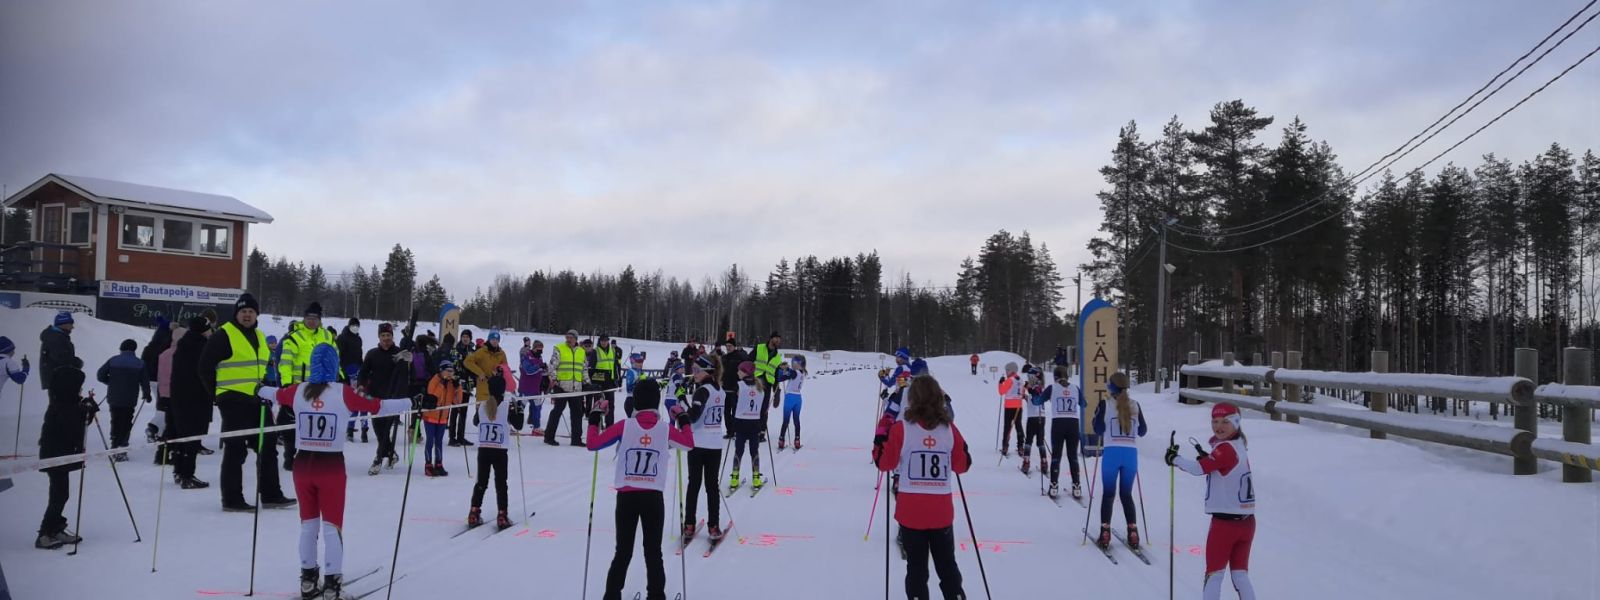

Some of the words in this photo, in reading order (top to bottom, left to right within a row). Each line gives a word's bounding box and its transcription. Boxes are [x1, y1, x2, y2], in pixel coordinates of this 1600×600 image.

[111, 282, 140, 293] Rauta
[141, 285, 194, 298] Rautapohja
[1062, 398, 1073, 411] 12
[711, 407, 722, 423] 13
[308, 415, 327, 438] 19
[486, 424, 498, 441] 15
[634, 450, 653, 474] 17
[920, 453, 940, 478] 18
